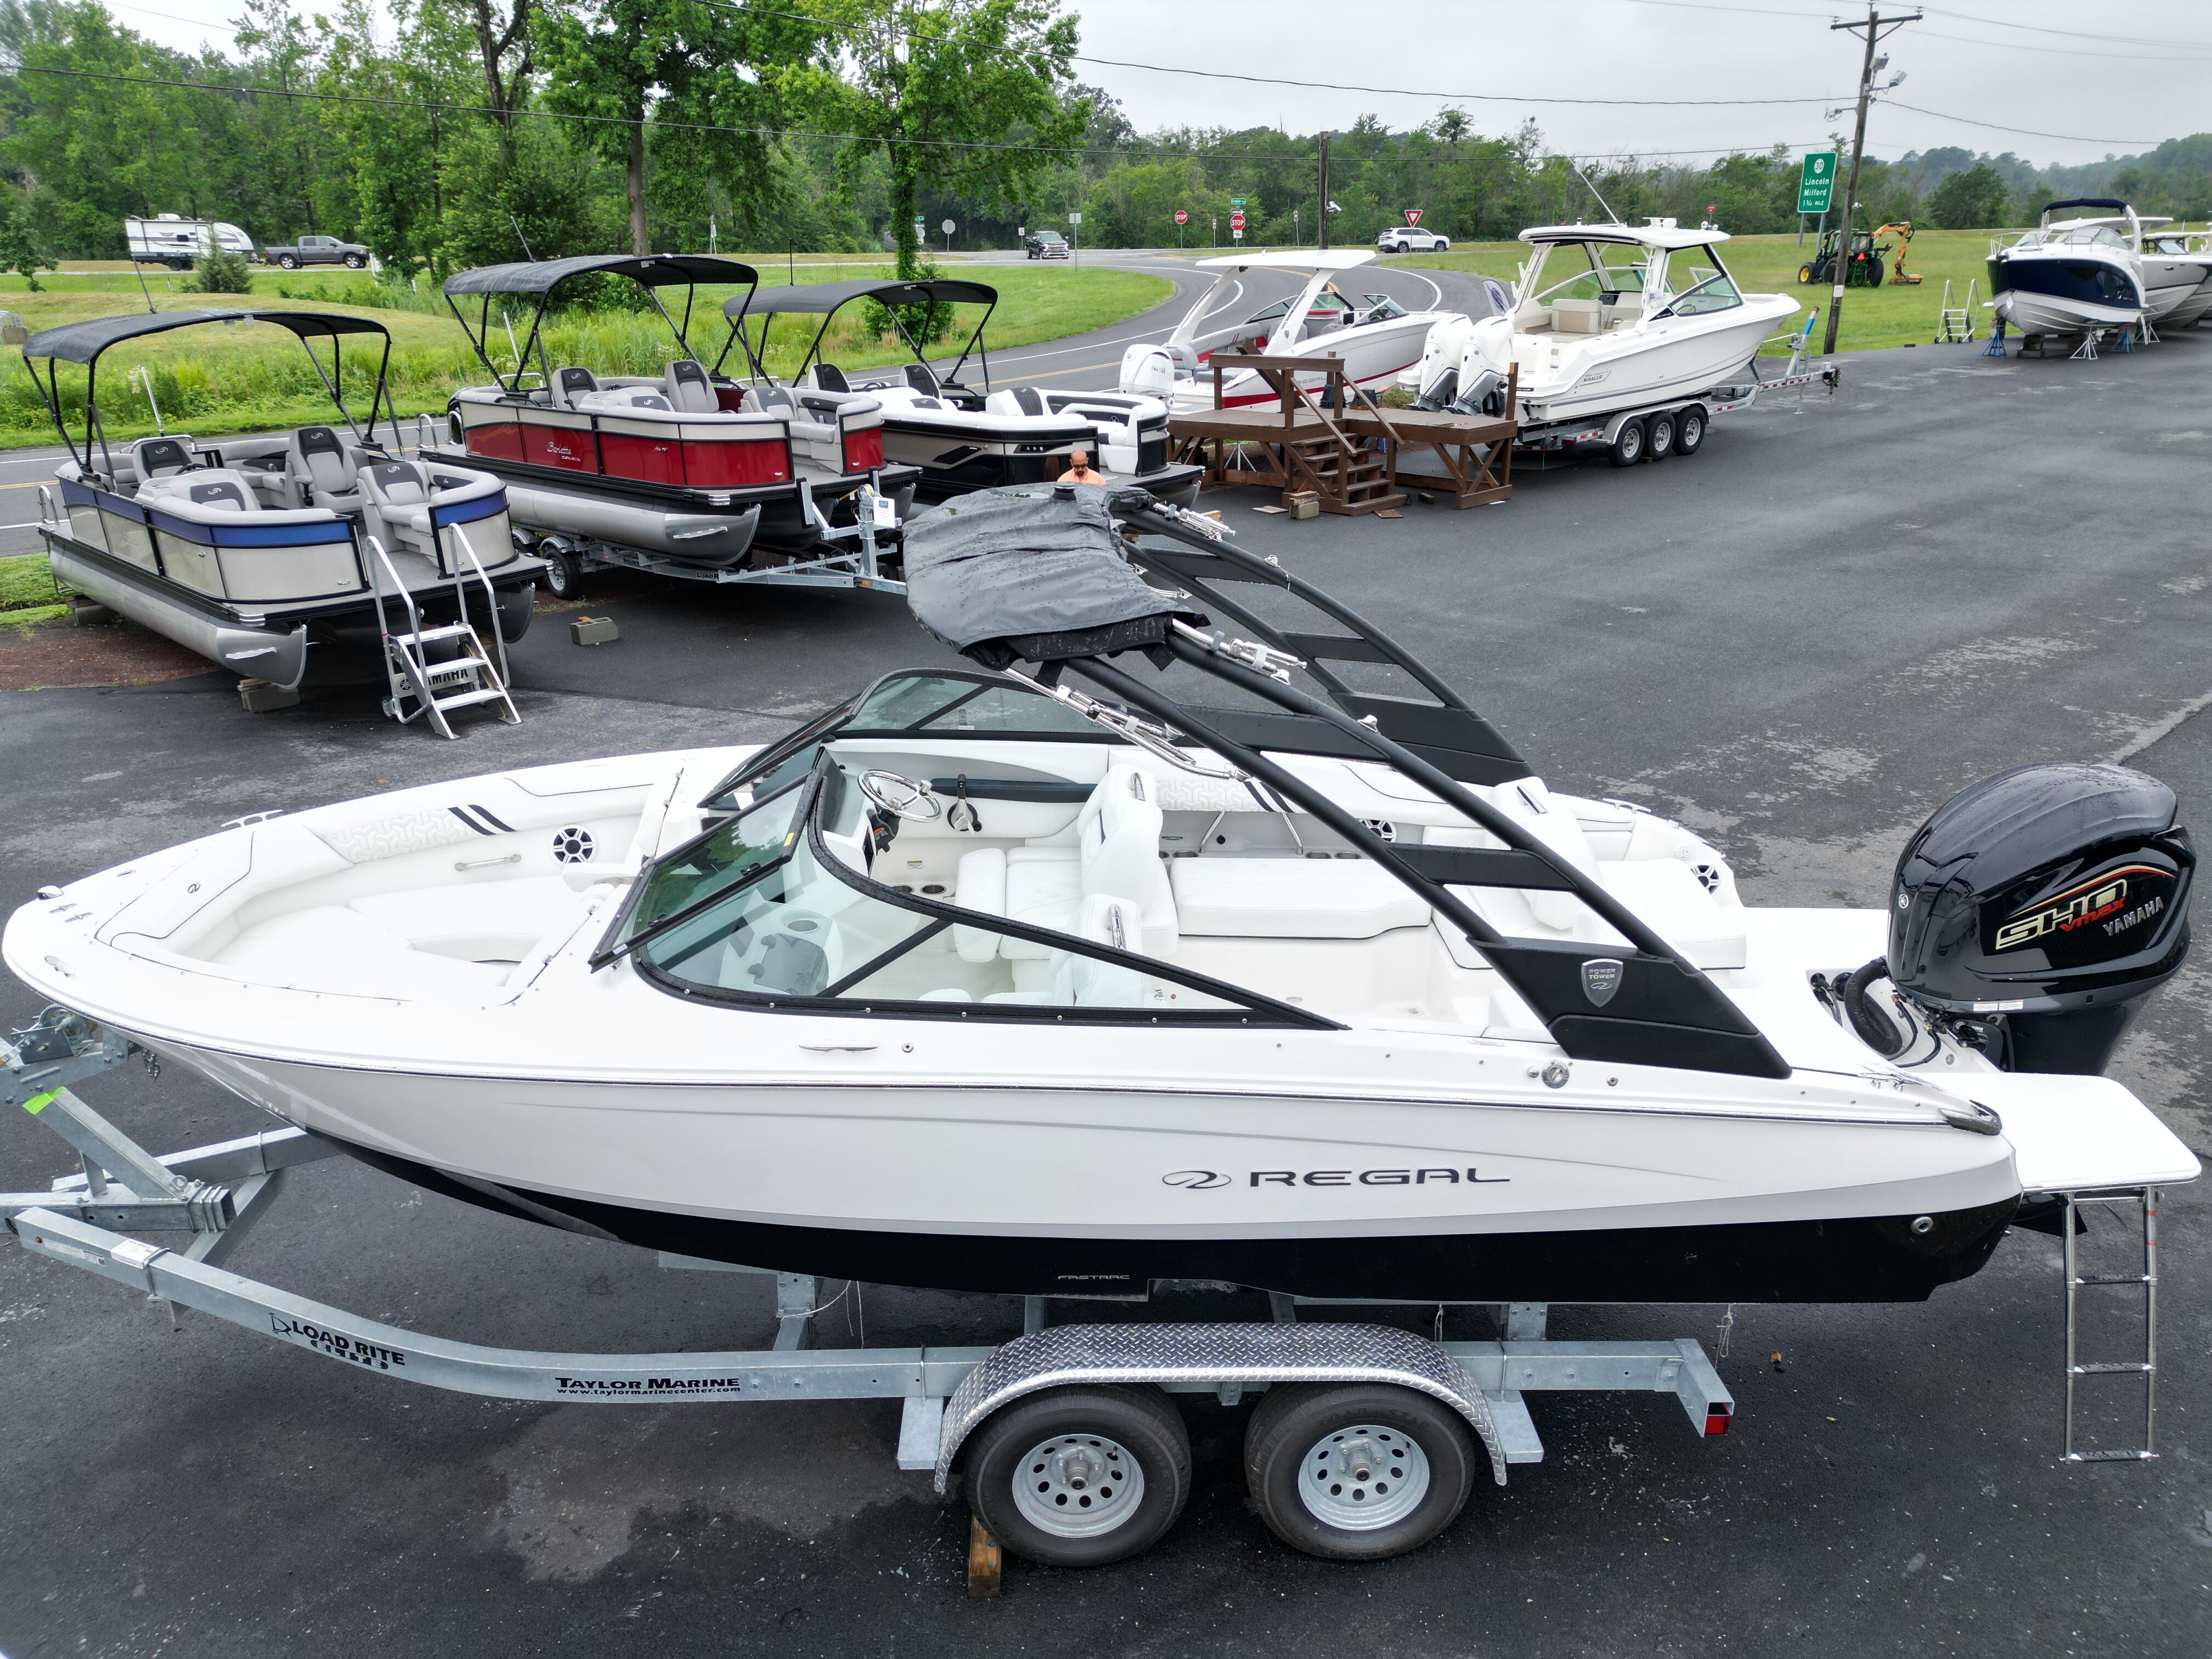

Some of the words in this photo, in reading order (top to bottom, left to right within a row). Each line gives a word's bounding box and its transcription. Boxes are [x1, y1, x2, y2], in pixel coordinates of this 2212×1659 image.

[1815, 162, 1824, 170] 30
[1996, 879, 2127, 950] SHO
[2103, 896, 2164, 936] YAMAHA
[1250, 1167, 1510, 1187] REGAL
[292, 1320, 350, 1350] LOAD
[354, 1341, 405, 1366] RITE
[313, 1340, 387, 1370] ELITE
[555, 1377, 641, 1389] TAYLOR
[648, 1378, 740, 1389] MARINE
[557, 1387, 741, 1396] www.taylormarinecenter.com
